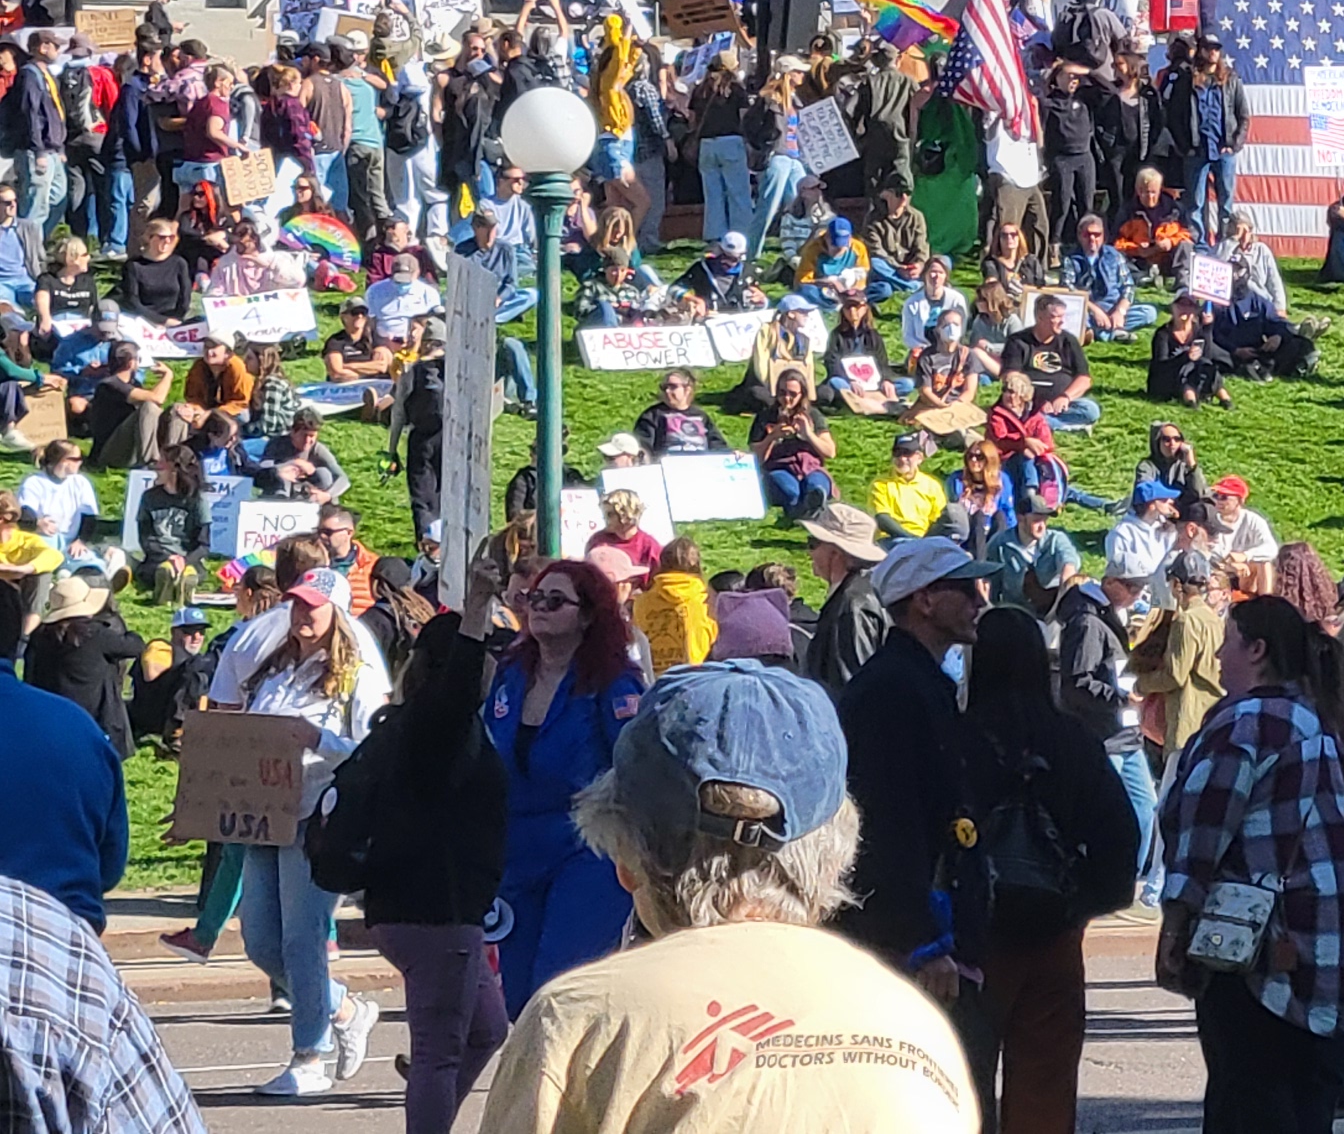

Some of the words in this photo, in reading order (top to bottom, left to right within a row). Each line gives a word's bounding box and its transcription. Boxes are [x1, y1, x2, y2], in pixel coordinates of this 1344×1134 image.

[602, 330, 664, 351] ABUSE
[667, 331, 696, 348] OF
[623, 347, 692, 368] POWER
[262, 514, 297, 533] NO
[260, 758, 293, 790] USA
[218, 811, 271, 842] USA
[755, 1032, 844, 1052] MEDECINS
[851, 1033, 894, 1050] SANS
[755, 1051, 836, 1069] DOCTORS
[843, 1051, 918, 1072] WITHOUT
